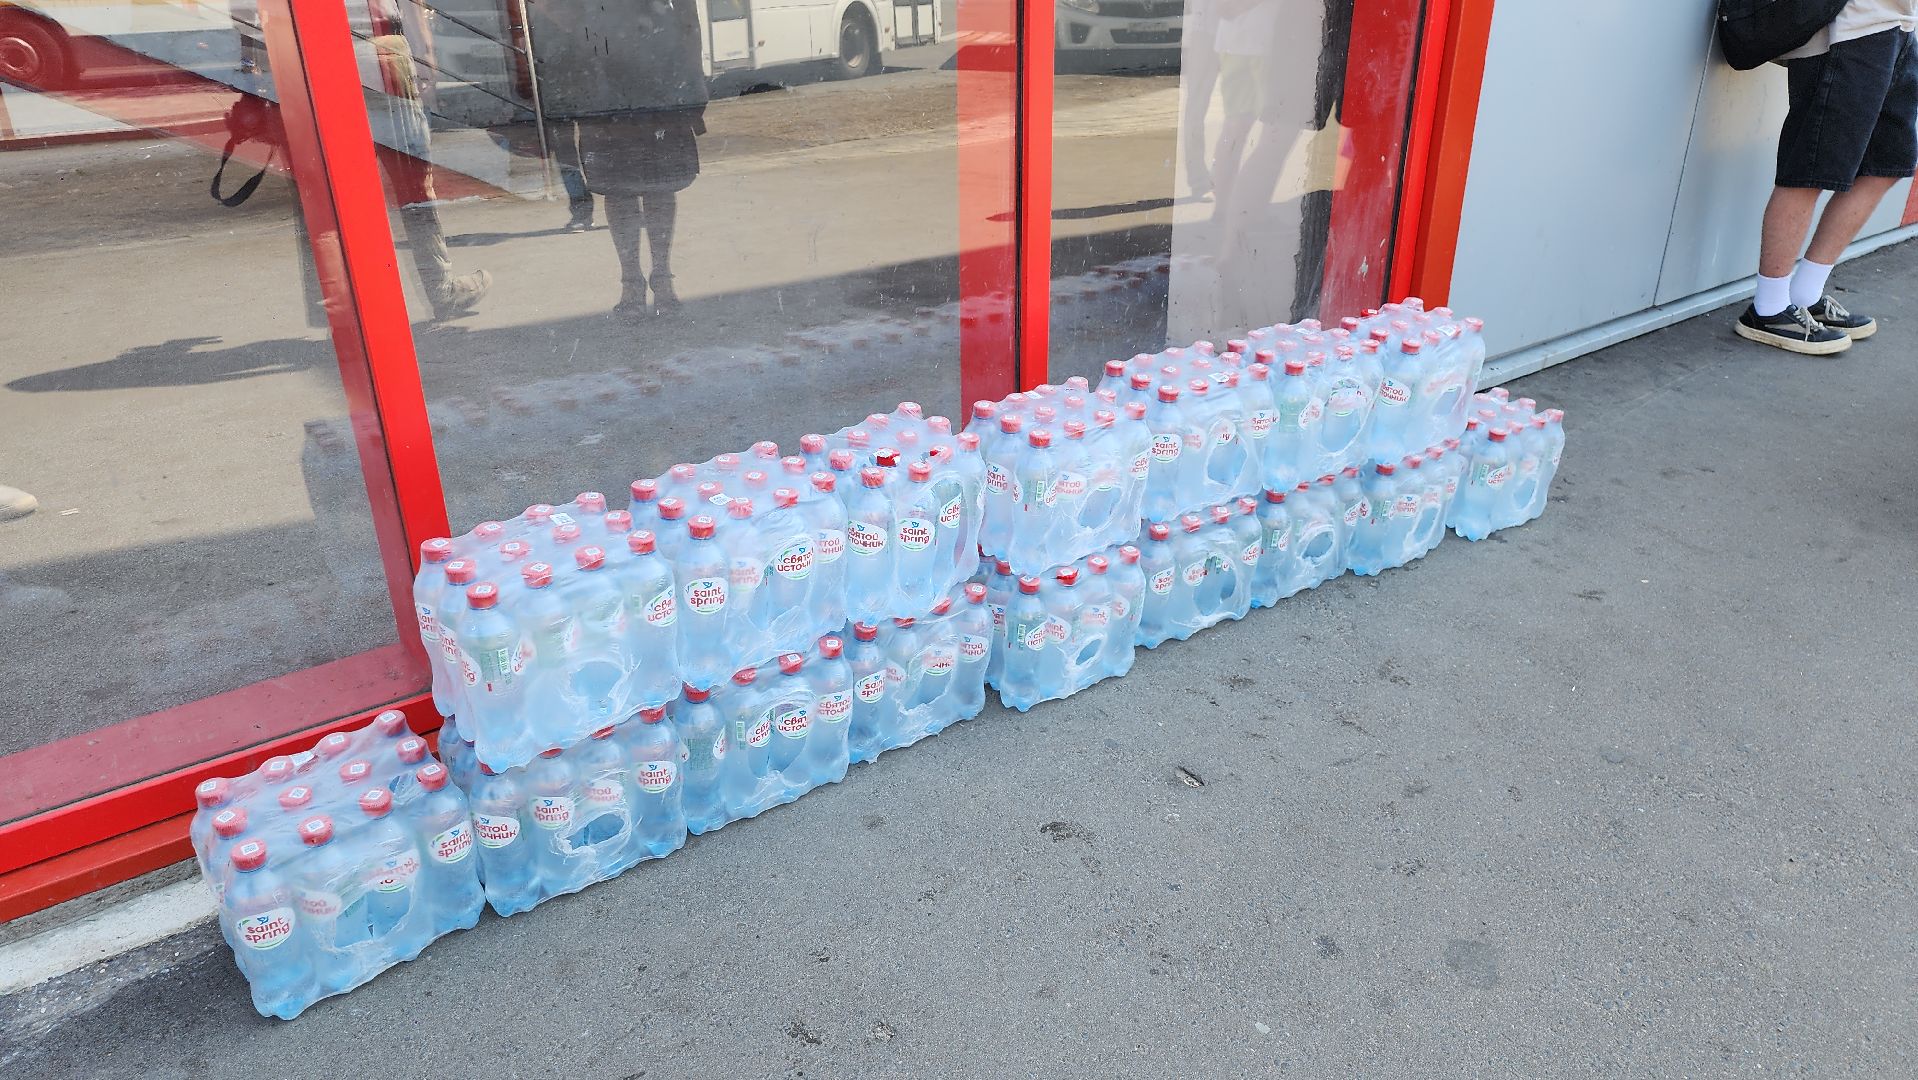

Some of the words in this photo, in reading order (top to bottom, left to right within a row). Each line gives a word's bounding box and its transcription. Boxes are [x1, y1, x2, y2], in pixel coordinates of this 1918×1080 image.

[902, 528, 928, 536] saint
[899, 534, 930, 544] spring
[693, 586, 723, 598] saint
[690, 594, 725, 607] spring
[784, 716, 807, 726] свят
[640, 768, 668, 778] saint
[247, 917, 285, 934] saint
[244, 922, 290, 943] spring
